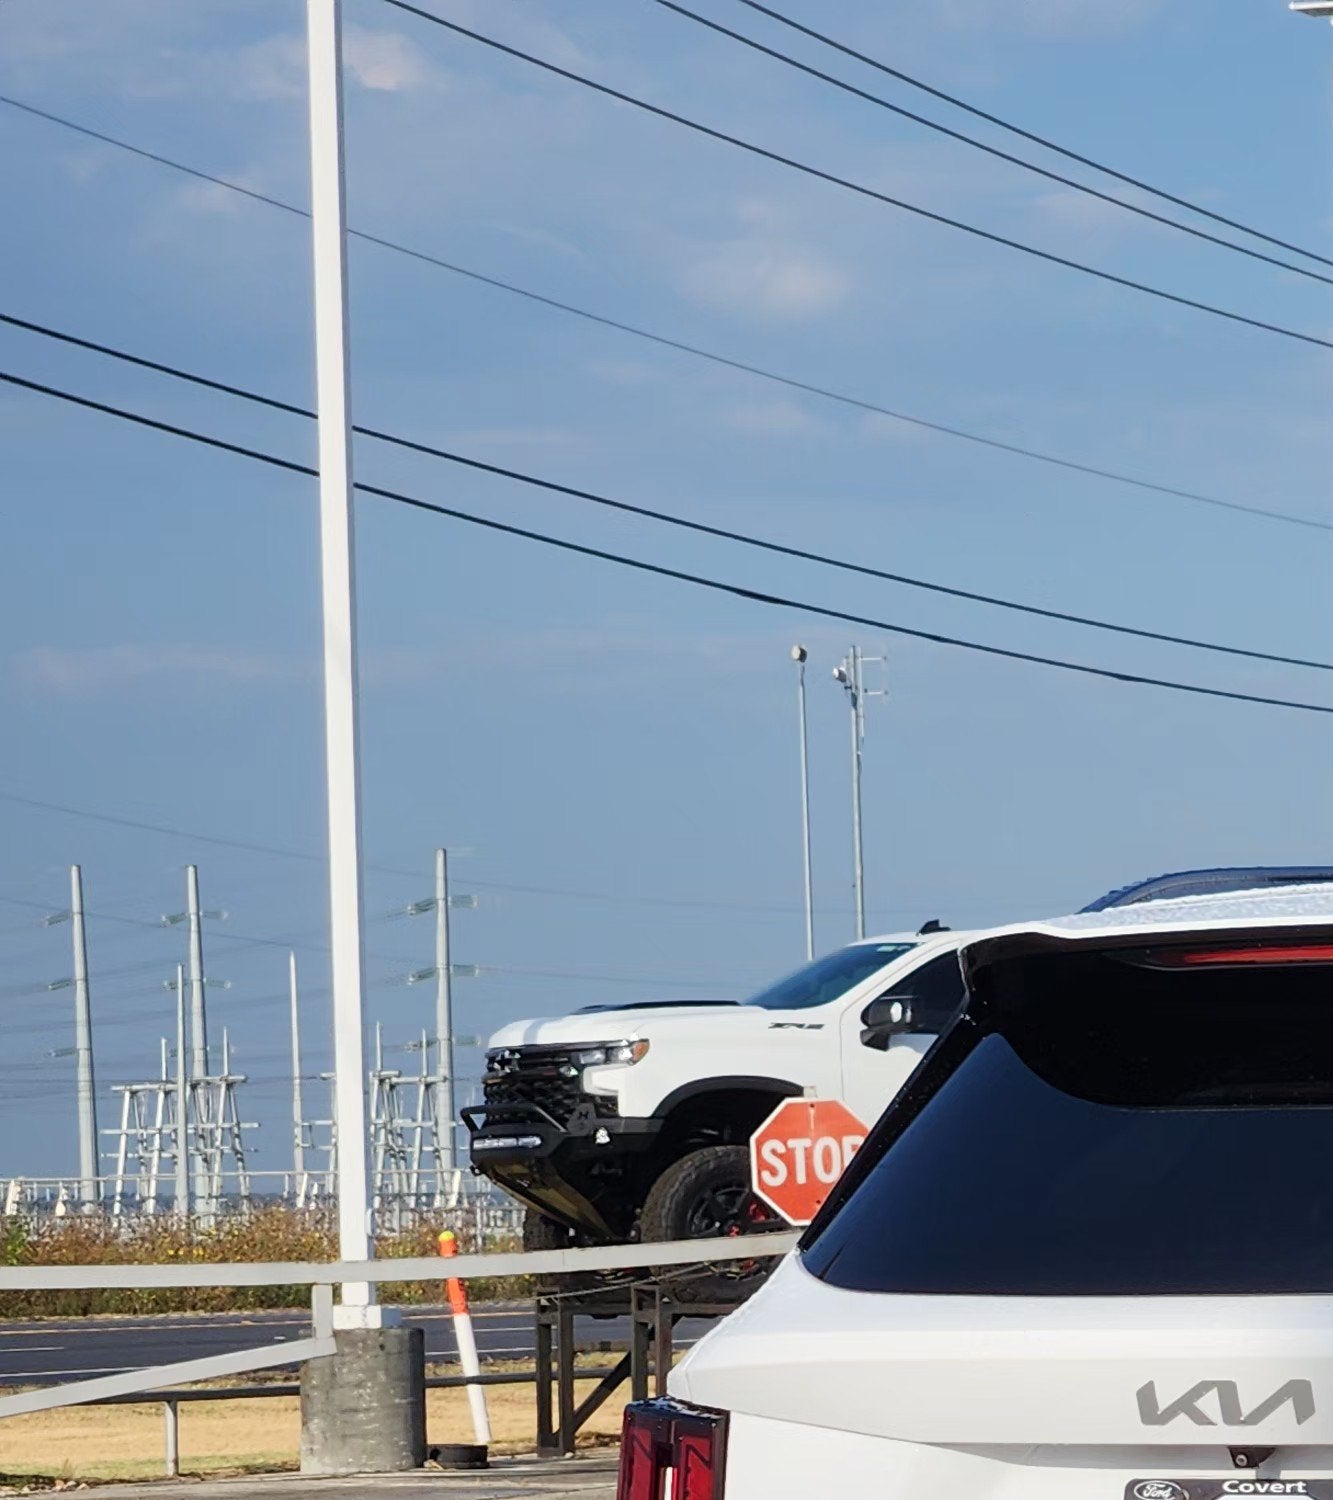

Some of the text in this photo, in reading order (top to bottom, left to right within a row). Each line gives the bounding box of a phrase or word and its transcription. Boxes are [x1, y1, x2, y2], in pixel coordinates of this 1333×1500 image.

[1135, 1379, 1316, 1426] KIA
[1142, 1482, 1175, 1499] Ford
[1222, 1480, 1307, 1494] Covert
